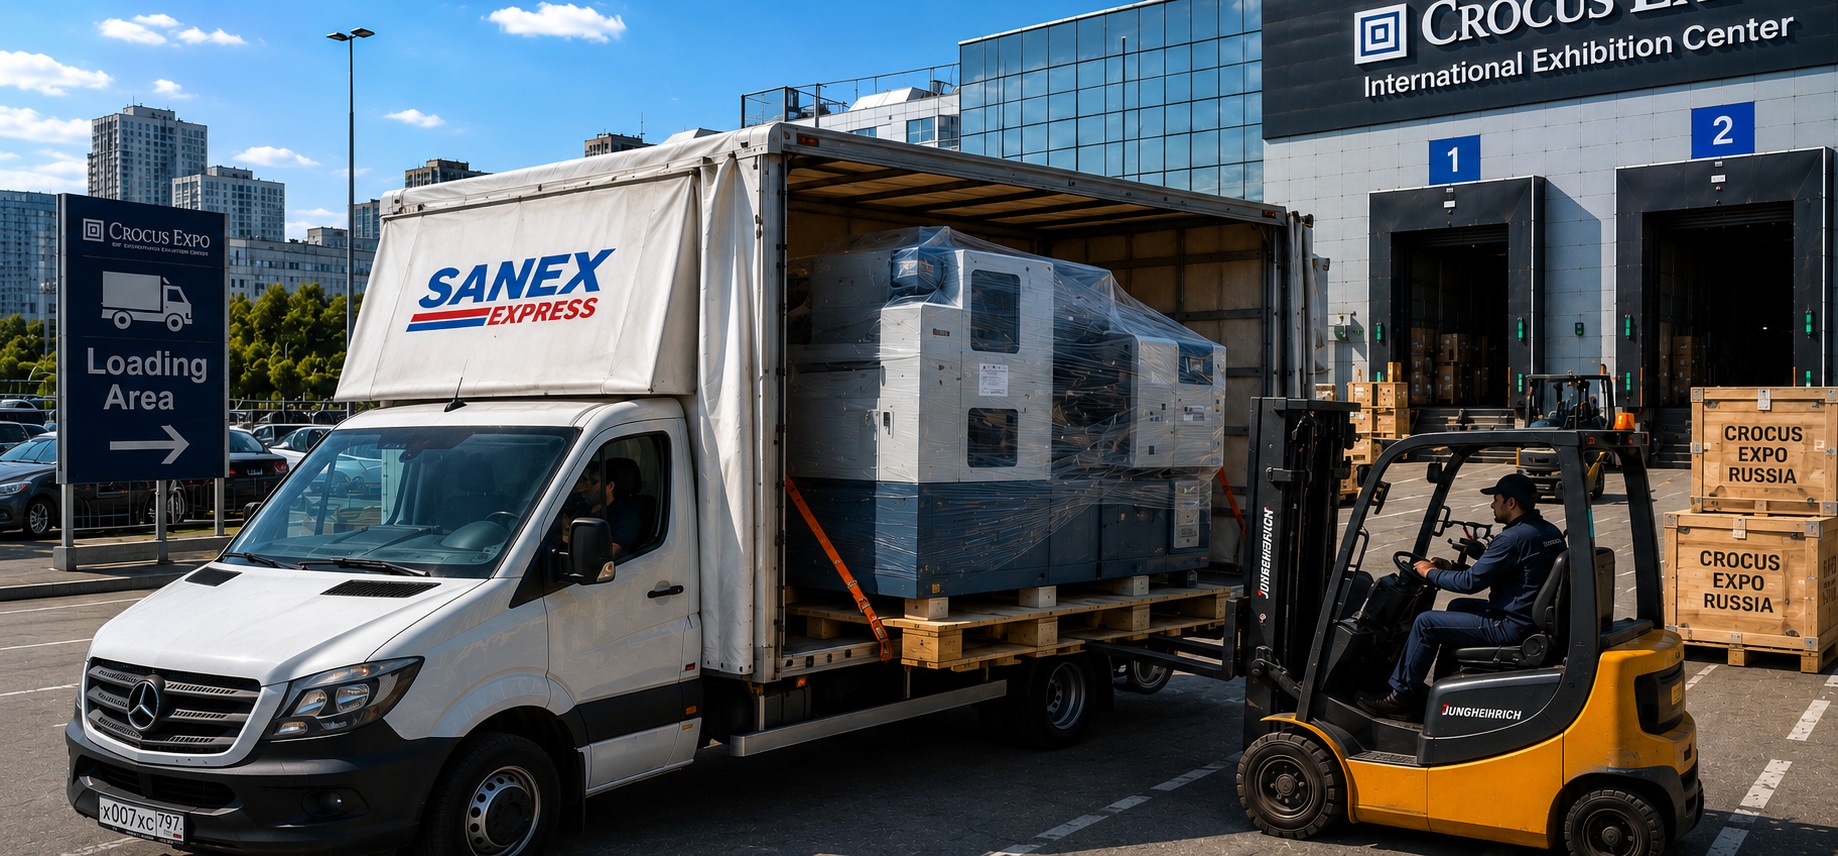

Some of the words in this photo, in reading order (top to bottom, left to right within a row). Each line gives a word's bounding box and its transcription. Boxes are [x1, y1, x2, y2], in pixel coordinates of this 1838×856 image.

[1422, 0, 1614, 45] CROCUS
[1364, 51, 1523, 98] International
[1533, 35, 1673, 73] Exhibition
[1682, 15, 1795, 51] Center
[1712, 115, 1734, 146] 2
[1446, 147, 1460, 173] 1
[109, 222, 169, 245] CROCUS
[173, 229, 211, 249] EXPO
[418, 248, 616, 309] SANEX
[487, 297, 598, 326] EXPRESS
[87, 347, 208, 383] Loading
[103, 384, 175, 410] Area
[1724, 425, 1803, 442] CROCUS
[1738, 446, 1788, 463] EXPO
[1728, 467, 1797, 484] RUSSIA
[1700, 550, 1780, 571] CROCUS
[1713, 572, 1765, 591] EXPO
[1703, 593, 1774, 613] RUSSIA
[158, 813, 180, 831] 797
